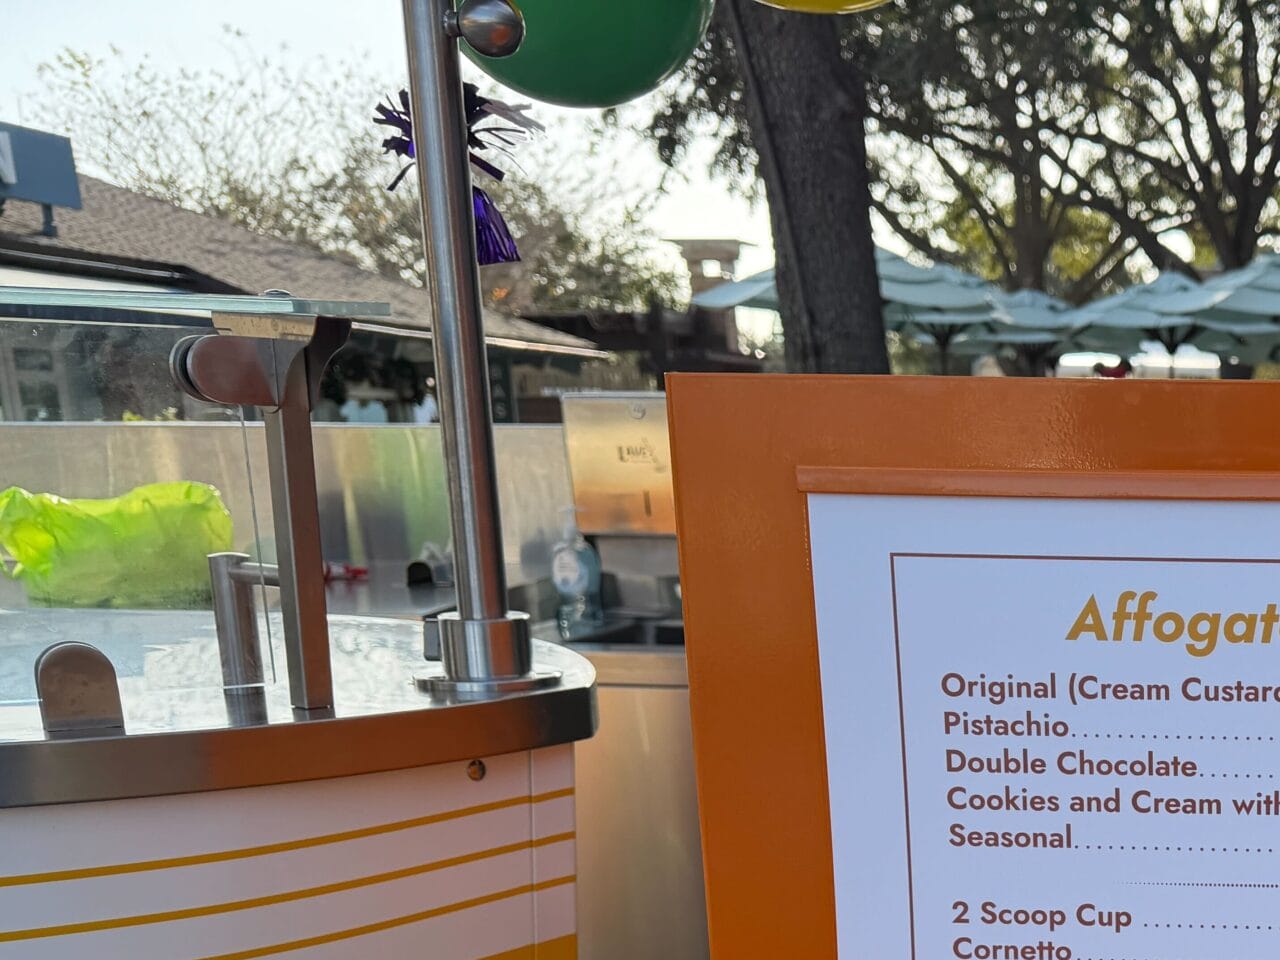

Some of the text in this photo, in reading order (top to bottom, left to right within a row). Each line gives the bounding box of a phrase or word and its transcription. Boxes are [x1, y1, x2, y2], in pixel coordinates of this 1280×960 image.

[940, 673, 1056, 705] Original
[1068, 673, 1169, 705] (Cream
[943, 711, 1068, 737] Pistachio
[945, 748, 1046, 774] Double
[1056, 750, 1197, 777] Chocolate
[946, 786, 1059, 812] Cookies
[1069, 788, 1120, 812] and
[1131, 790, 1221, 814] Cream
[948, 824, 1071, 848] Seasonal
[951, 901, 969, 923] 2
[980, 902, 1066, 931] Scoop
[1075, 904, 1131, 933] Cup
[952, 937, 1071, 960] Cornetto
